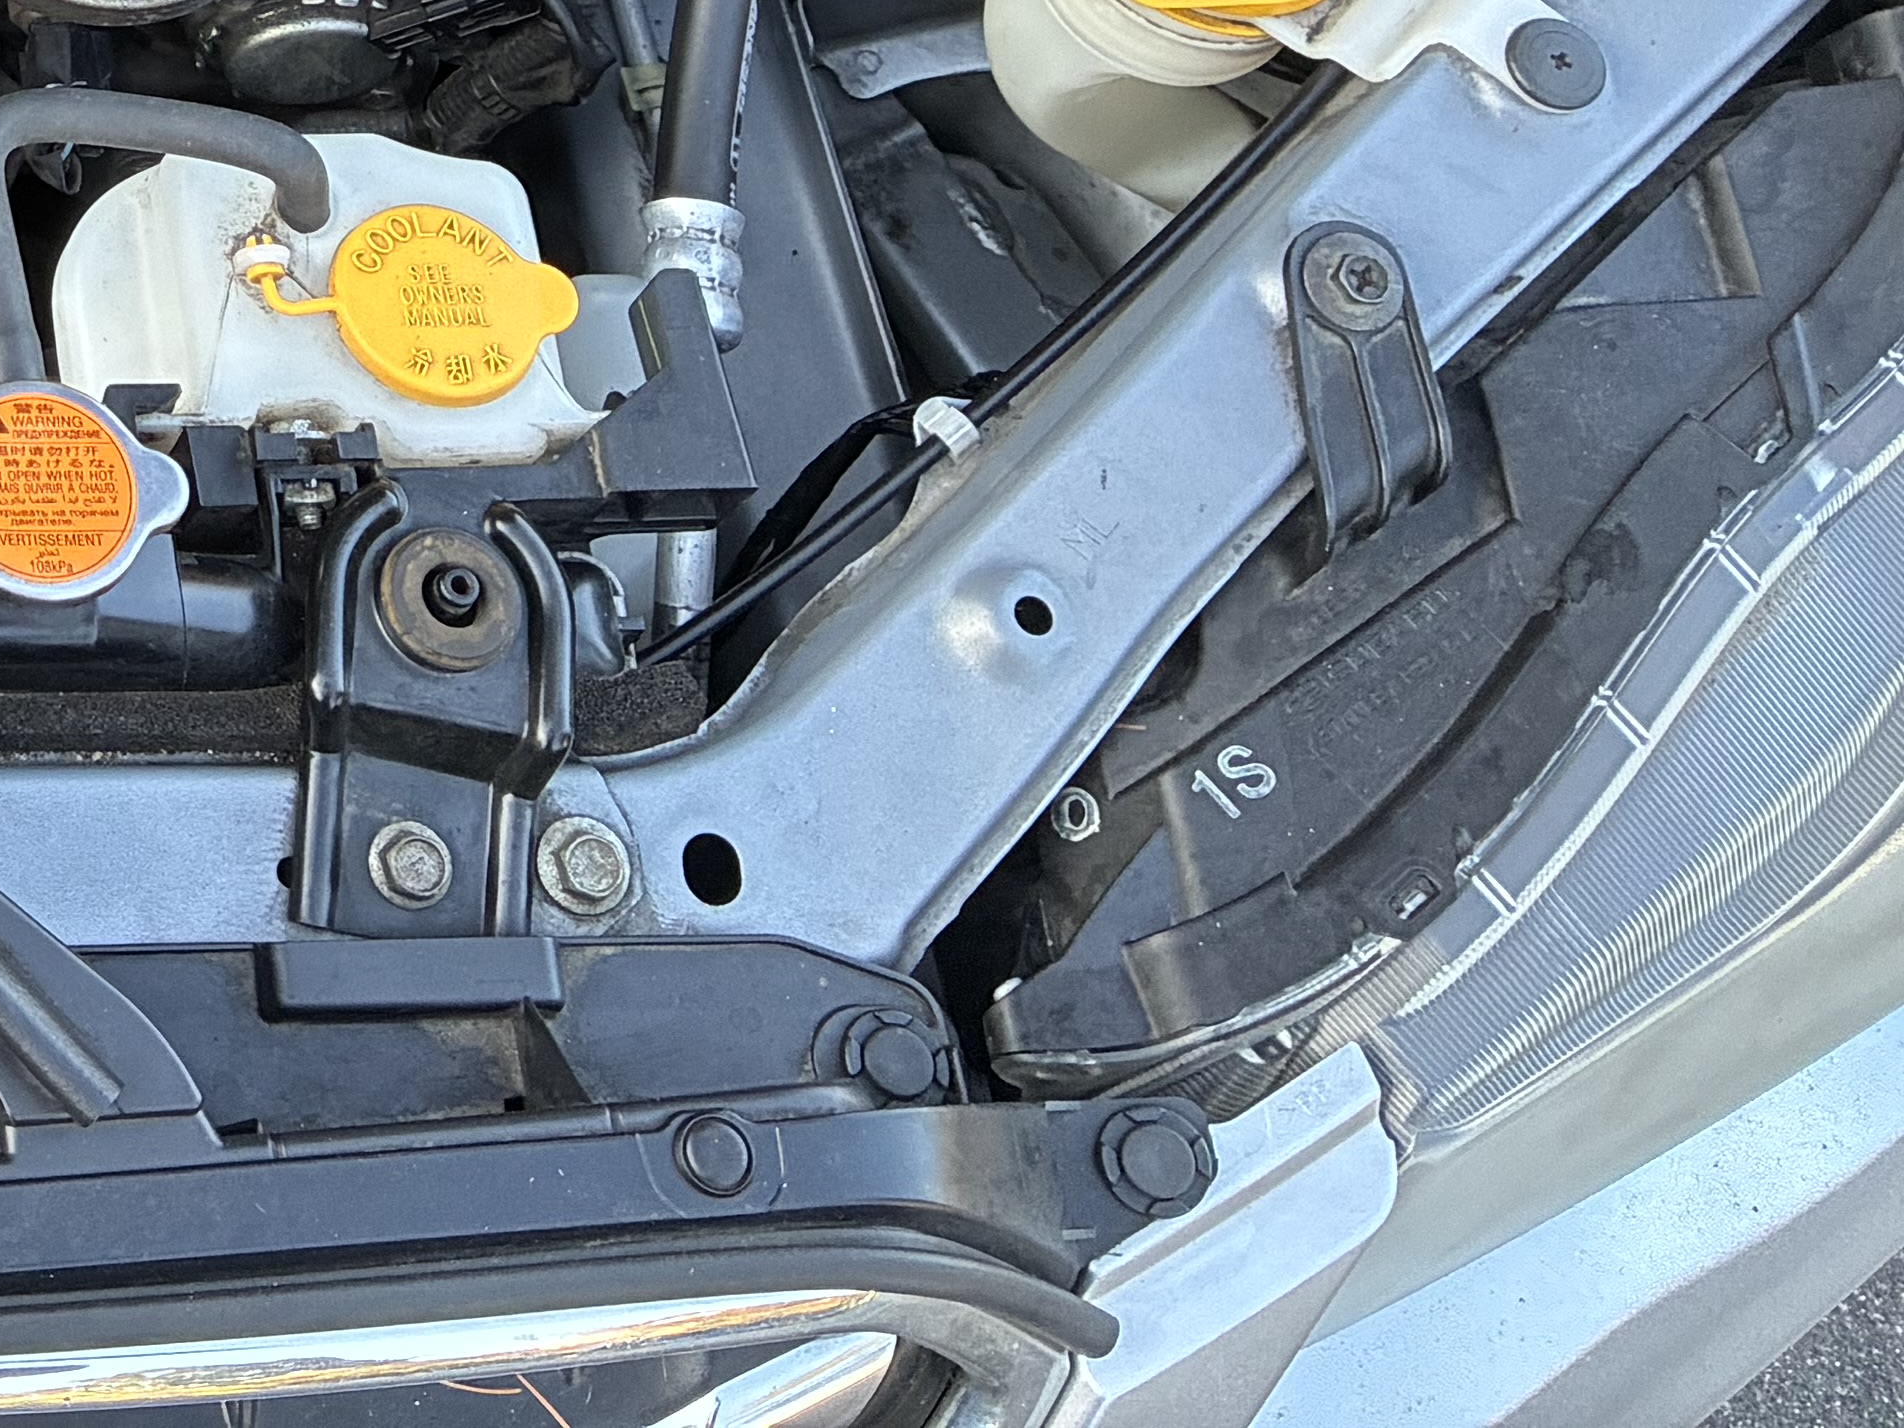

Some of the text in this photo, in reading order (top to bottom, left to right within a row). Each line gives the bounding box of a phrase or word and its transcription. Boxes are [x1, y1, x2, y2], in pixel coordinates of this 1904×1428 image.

[350, 211, 514, 273] COOLANT
[408, 263, 453, 283] SEE
[399, 284, 484, 304] OWNERS
[403, 307, 491, 327] MANUAL
[404, 343, 512, 385] 冷却水
[12, 402, 54, 414] 警告
[11, 415, 83, 427] WARNING
[7, 470, 40, 481] OPEN
[47, 470, 83, 481] WHEN
[89, 470, 117, 481] HOT.
[23, 482, 63, 493] OUVRIR
[79, 482, 118, 493] CHAUD.
[29, 559, 73, 573] 108kPa
[1190, 743, 1279, 819] 1S
